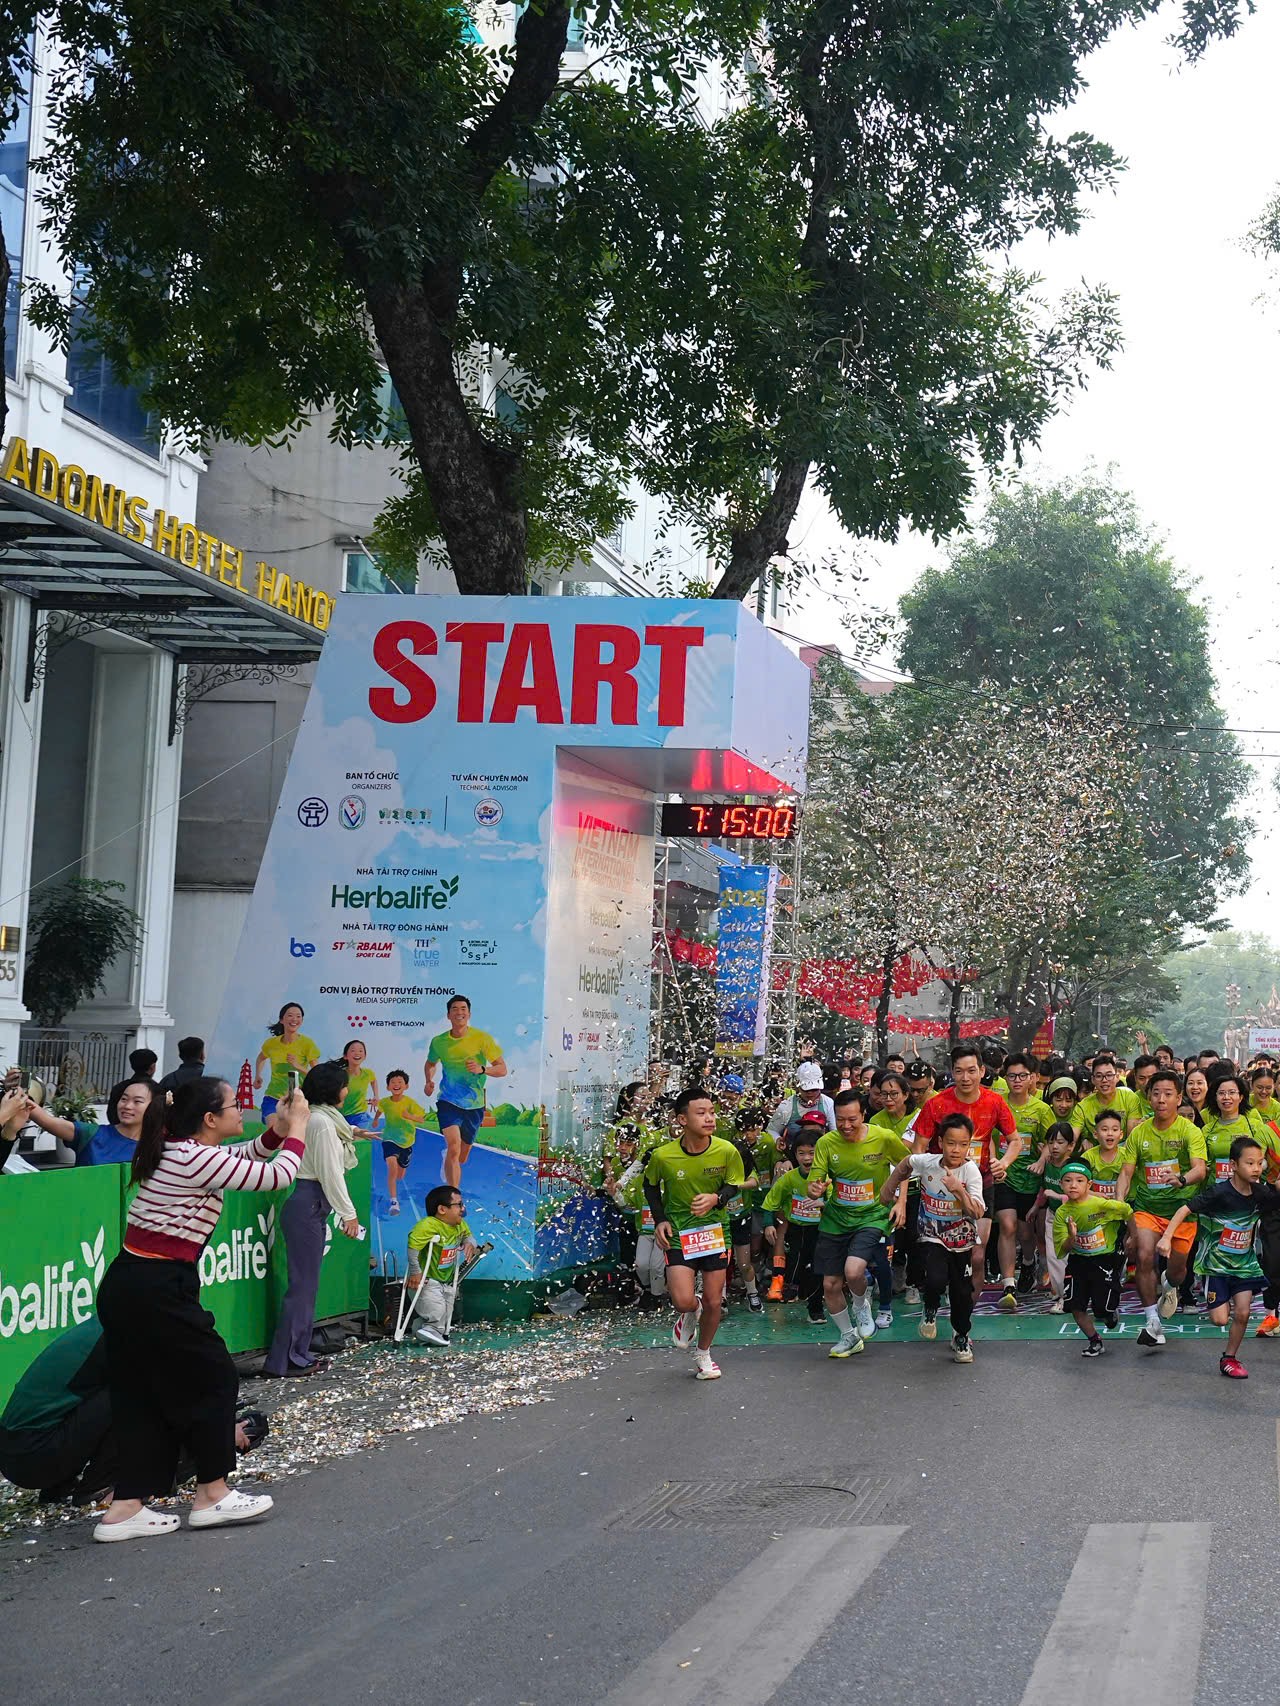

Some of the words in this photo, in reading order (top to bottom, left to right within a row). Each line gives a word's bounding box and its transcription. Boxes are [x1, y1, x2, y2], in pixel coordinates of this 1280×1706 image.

[3, 436, 149, 544] ADONIS
[153, 508, 248, 592] HOTEL
[368, 620, 704, 727] START
[345, 772, 363, 780] BAN
[376, 771, 399, 780] CHỨC
[451, 774, 462, 782] TƯ
[479, 773, 510, 782] CHUYÊN
[511, 774, 529, 782] MÔN
[578, 811, 641, 862] VIETNAM
[356, 867, 374, 876] NHÀ
[376, 867, 390, 876] TÀI
[392, 868, 410, 877] TRỢ
[411, 867, 438, 876] CHÍNH
[331, 884, 448, 910] Herbalife
[342, 922, 360, 931] NHÀ
[362, 922, 376, 931] TÀI
[378, 923, 396, 932] TRỢ
[424, 922, 448, 932] HÀNH
[290, 937, 316, 958] be
[414, 938, 430, 948] TH
[413, 949, 440, 960] true
[413, 960, 440, 968] WATER
[578, 964, 620, 996] Herbalife
[320, 986, 340, 994] ĐƠN
[341, 986, 350, 996] VỊ
[351, 984, 370, 995] BẢO
[371, 986, 389, 996] TRỢ
[425, 986, 456, 996] THÔNG
[562, 1026, 573, 1051] be
[843, 1184, 866, 1195] F1074
[688, 1230, 715, 1245] F1255
